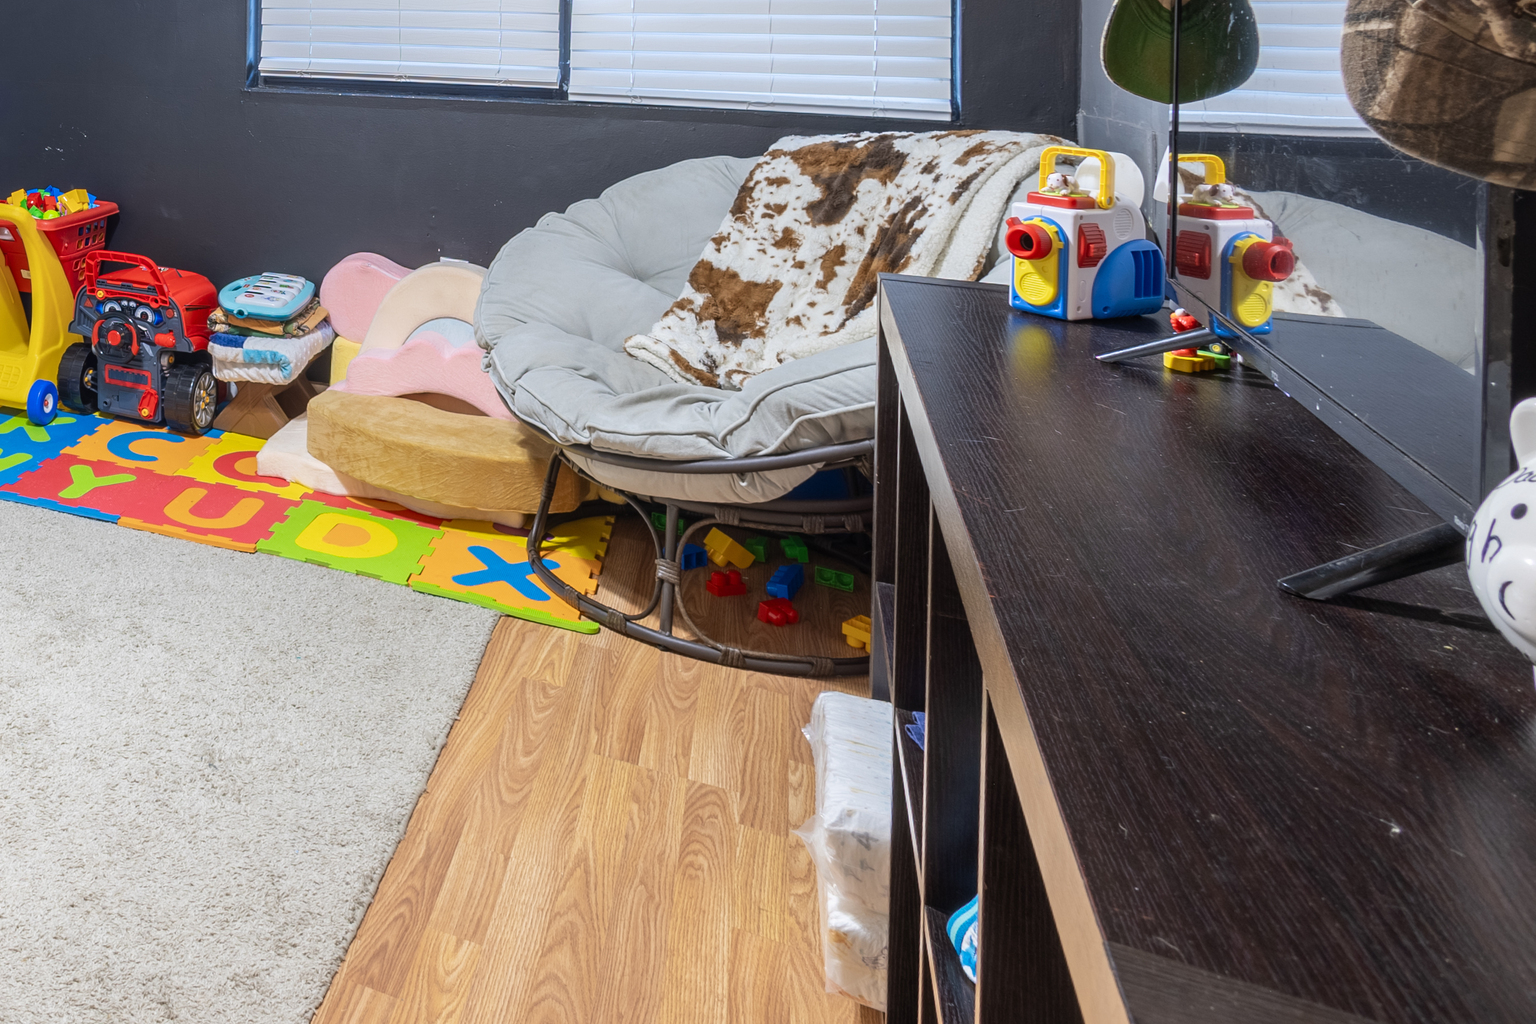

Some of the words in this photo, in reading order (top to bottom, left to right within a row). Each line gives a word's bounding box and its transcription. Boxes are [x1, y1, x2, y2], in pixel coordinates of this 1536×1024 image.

[107, 431, 185, 462] C
[58, 464, 137, 499] Y
[164, 487, 264, 529] U
[295, 512, 398, 559] D
[452, 545, 561, 601] X
